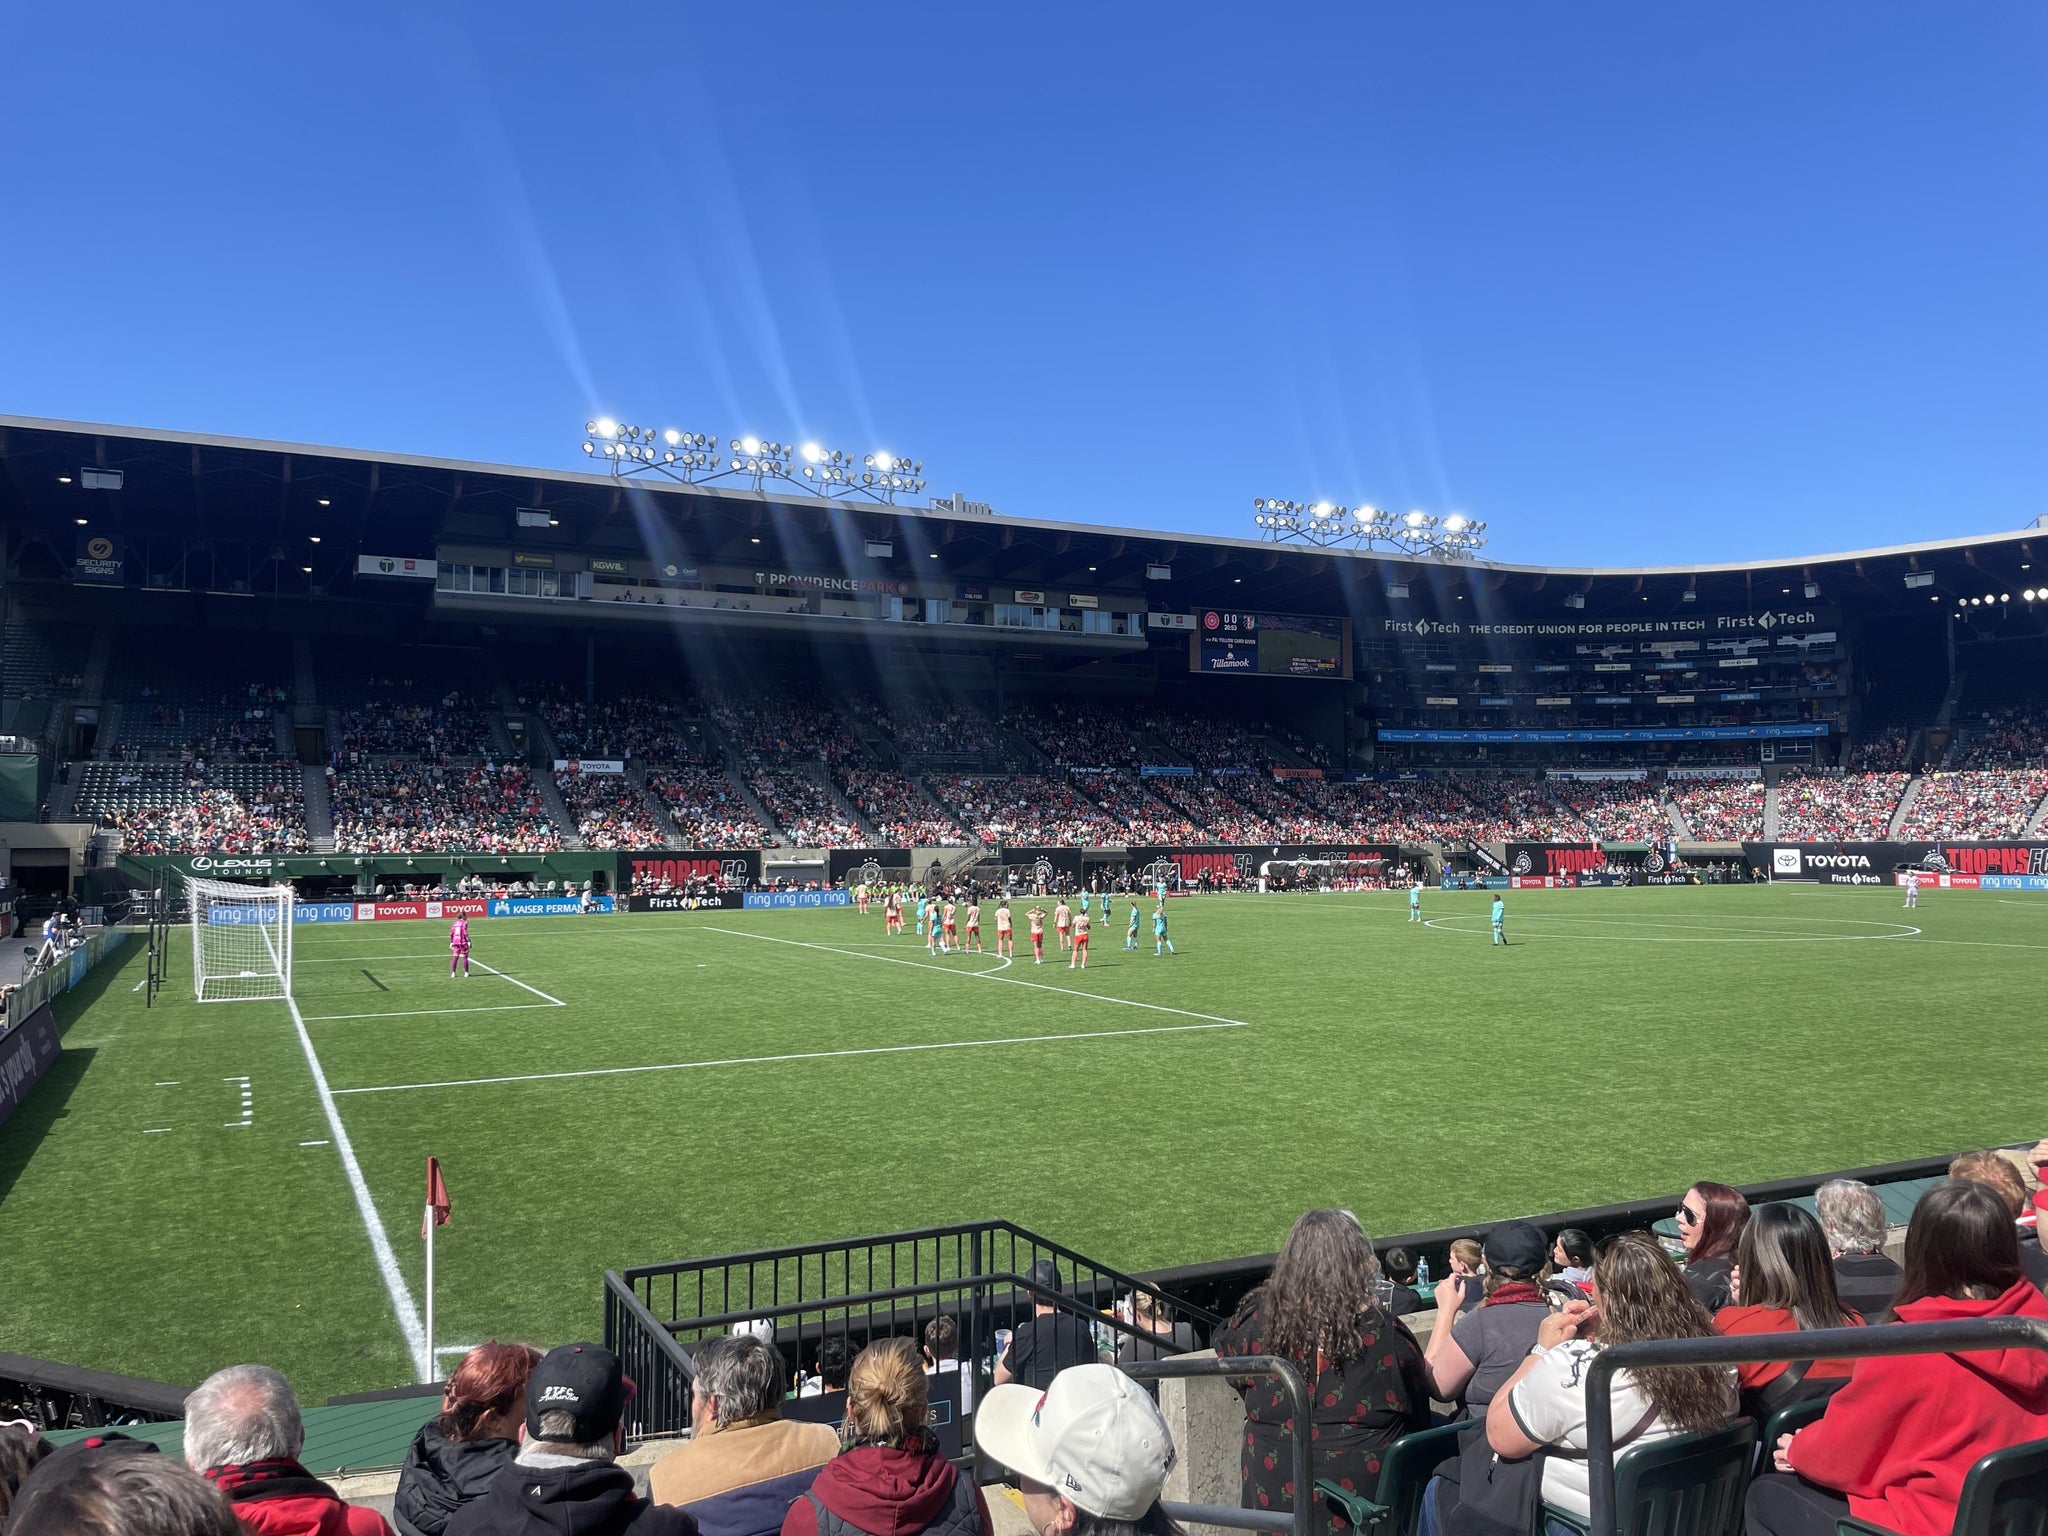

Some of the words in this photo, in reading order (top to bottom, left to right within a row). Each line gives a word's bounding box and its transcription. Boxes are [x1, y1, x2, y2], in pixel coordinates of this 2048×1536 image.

[76, 558, 123, 568] SECURITY
[84, 566, 115, 575] SIGNS
[769, 573, 859, 591] PROVIDENCE
[859, 580, 894, 593] PARK
[1717, 615, 1755, 629] First
[1778, 611, 1815, 624] Tech
[1385, 619, 1413, 633] First
[1431, 621, 1460, 634] Tech
[1469, 625, 1491, 634] THE
[1494, 625, 1534, 634] CREDIT
[1538, 625, 1576, 634] UNION
[1579, 624, 1603, 633] FOR
[1606, 622, 1652, 633] PEOPLE
[1656, 622, 1669, 632] IN
[1671, 620, 1706, 631] TECH
[1211, 658, 1250, 669] Tillamook
[1701, 729, 1716, 738] ring
[1765, 727, 1780, 736] ring
[213, 859, 272, 868] LEXUS
[1171, 854, 1233, 880] THORNS
[1233, 853, 1253, 880] FC
[1545, 850, 1605, 873] THORNS
[1805, 855, 1871, 867] TOYOTA
[1946, 848, 2029, 874] THORNS
[631, 859, 720, 888] THORNS
[1647, 875, 1663, 884] First
[1671, 875, 1686, 884] Tech
[1832, 874, 1851, 884] First
[1861, 874, 1881, 884] Tech
[1981, 876, 2000, 888] ring
[2003, 876, 2022, 888] ring
[649, 897, 678, 908] First
[696, 896, 722, 907] Tech
[748, 895, 771, 908] ring
[774, 893, 796, 906] ring
[799, 892, 821, 906] ring
[824, 891, 845, 905] ring
[212, 907, 242, 923] ring
[323, 905, 352, 921] ring
[378, 906, 418, 915] TOYOTA
[445, 904, 484, 913] TOYOTA
[513, 904, 544, 914] KAISER
